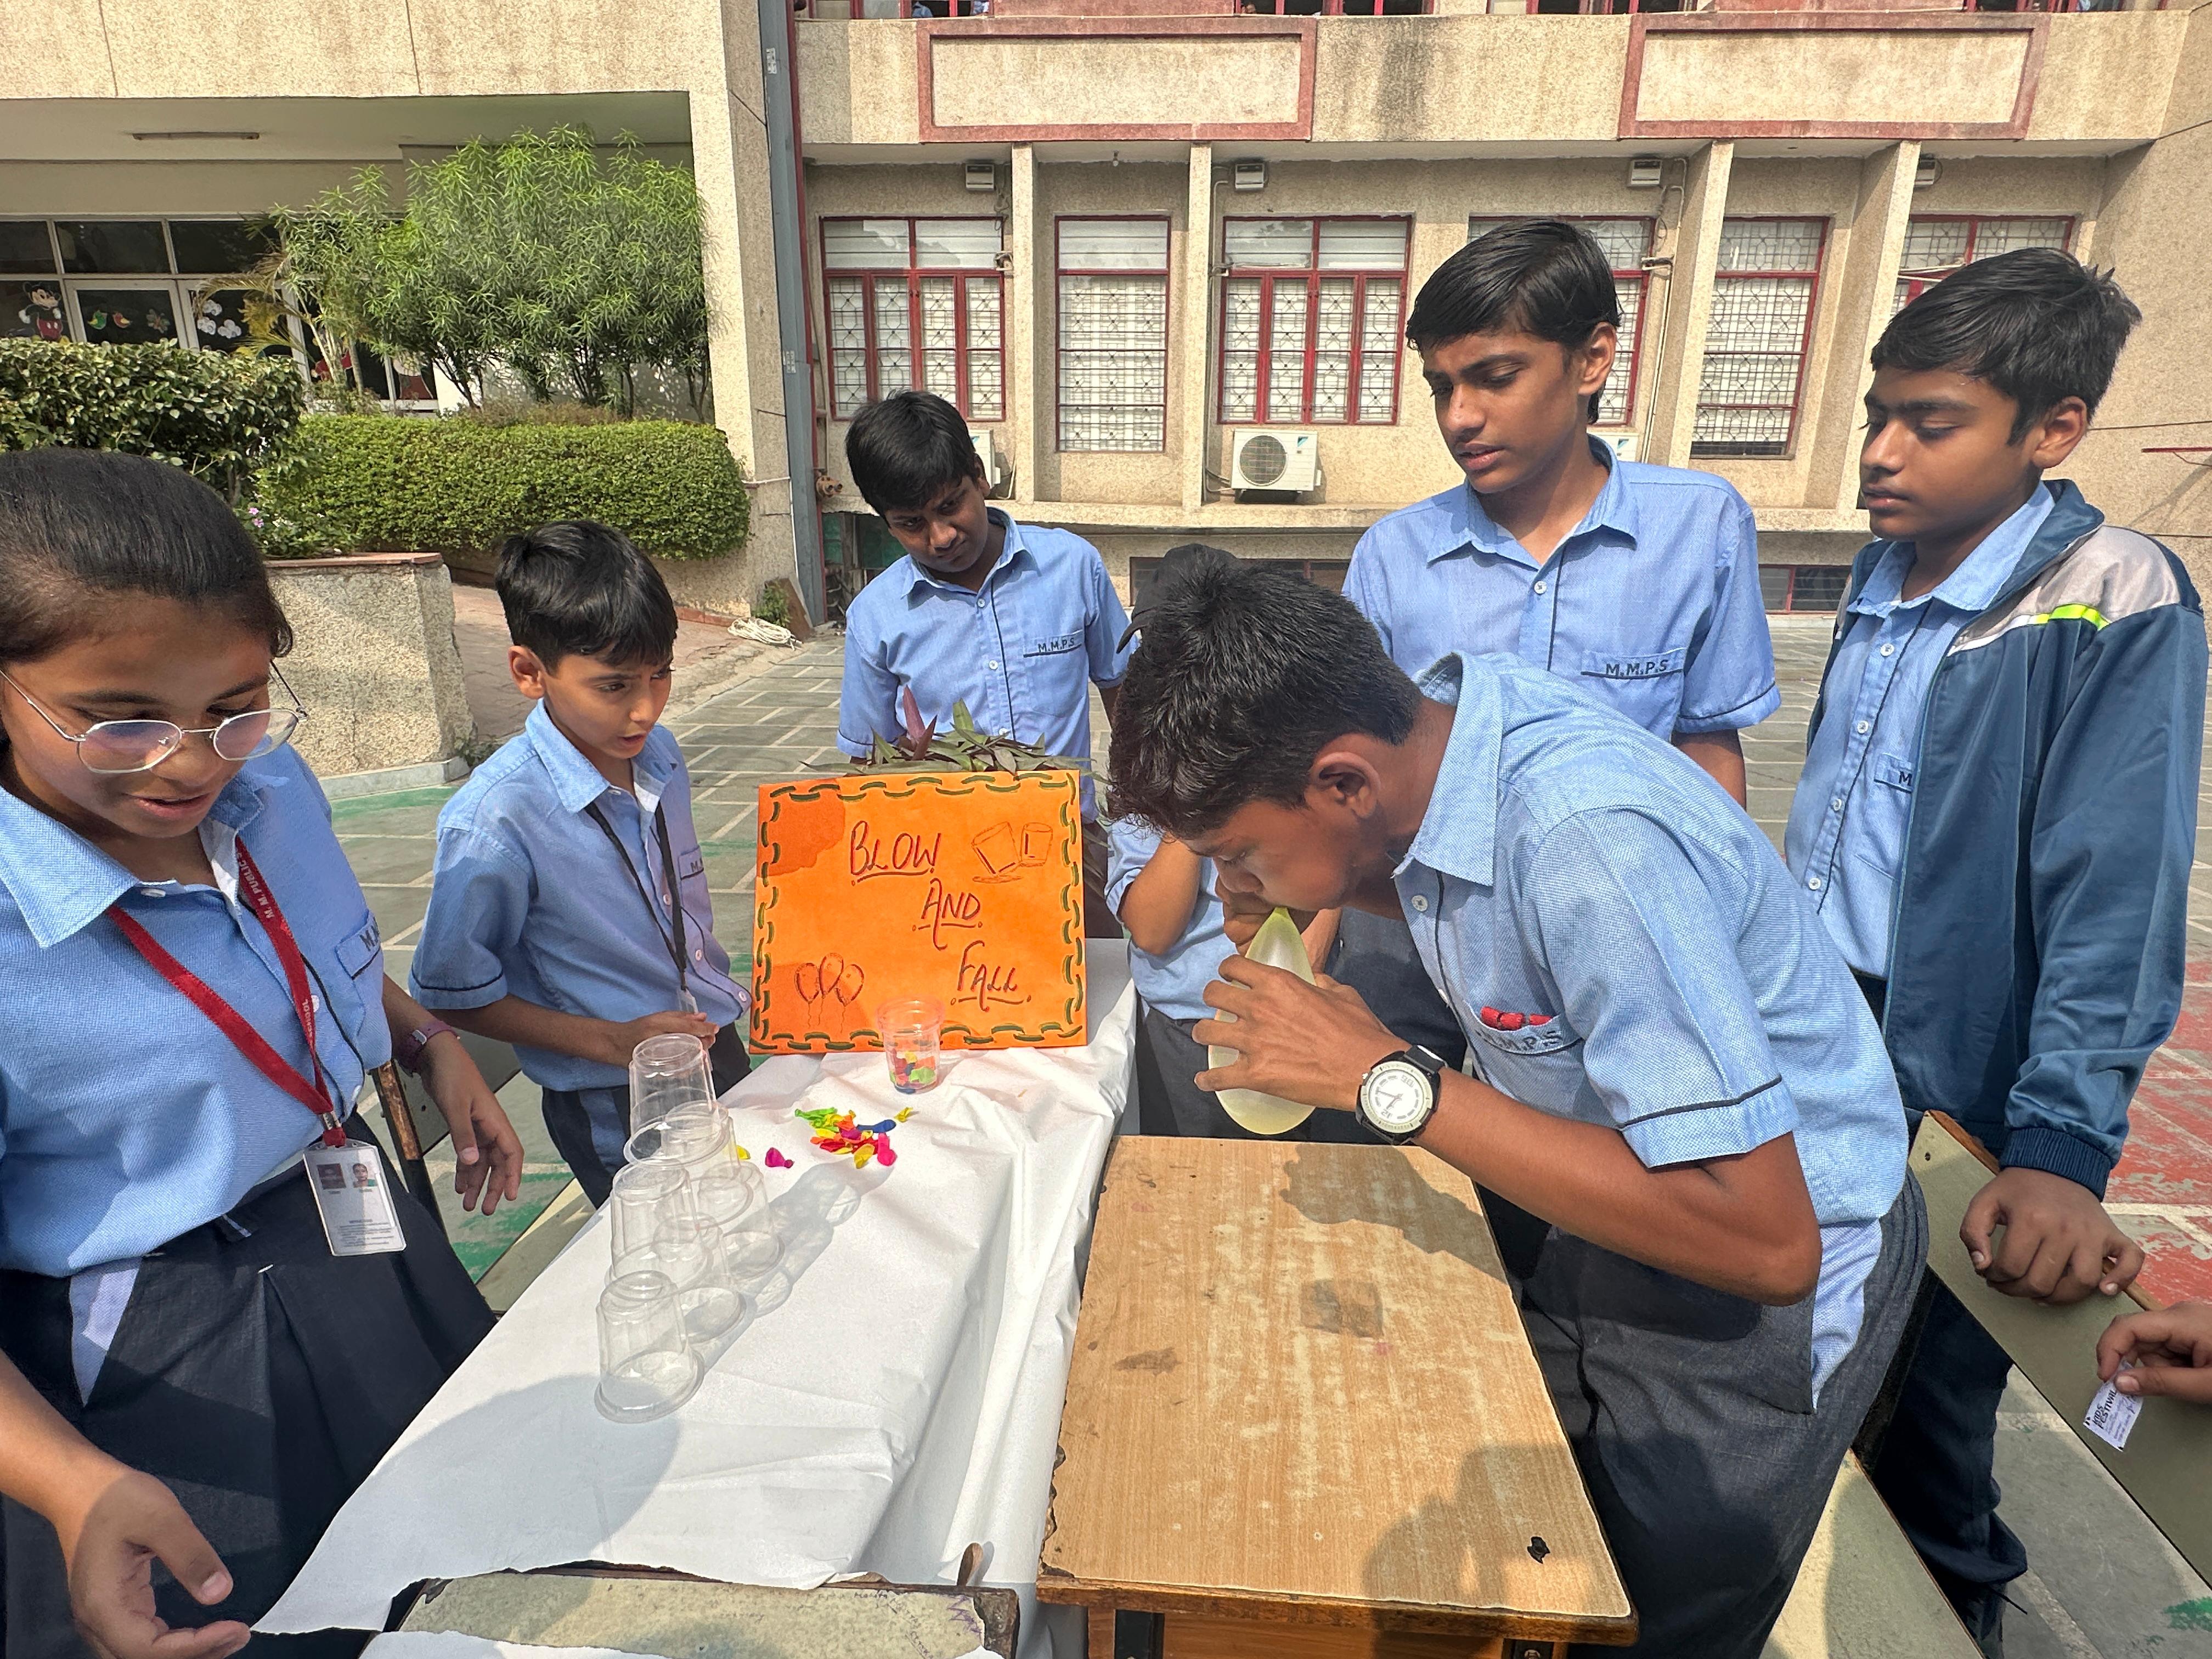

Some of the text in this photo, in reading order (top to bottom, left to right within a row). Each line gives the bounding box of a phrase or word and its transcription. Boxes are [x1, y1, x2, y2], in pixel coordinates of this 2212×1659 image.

[850, 820, 941, 876] BLOW
[921, 878, 981, 950] AND
[956, 940, 1019, 1012] FALL
